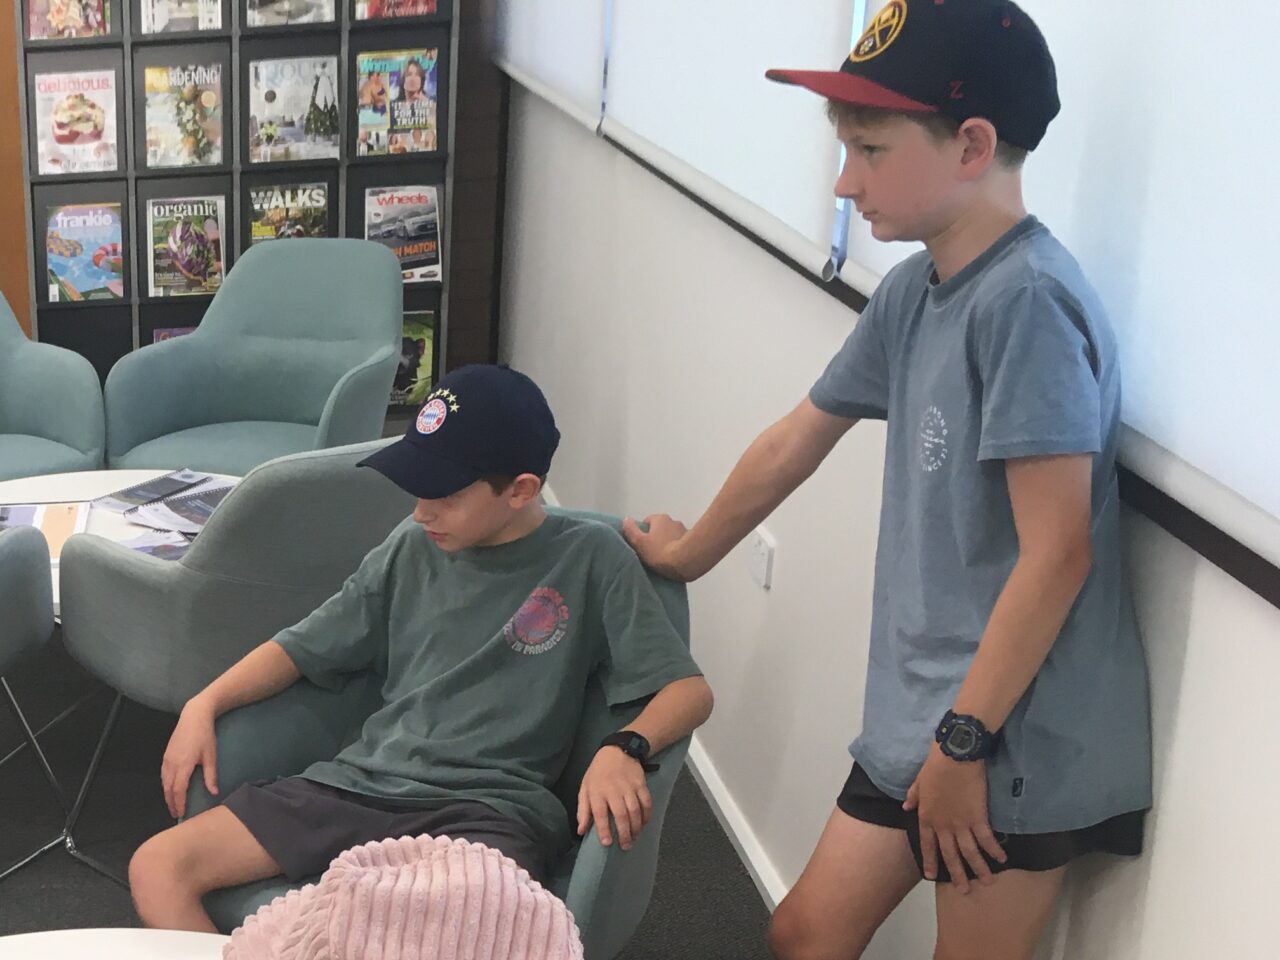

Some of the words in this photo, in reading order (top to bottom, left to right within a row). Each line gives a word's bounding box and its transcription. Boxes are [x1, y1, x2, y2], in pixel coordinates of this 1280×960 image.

[250, 189, 326, 209] WALKS
[376, 193, 429, 206] wheels
[55, 209, 113, 229] frankie
[153, 200, 217, 222] organic
[404, 240, 436, 256] MATCH
